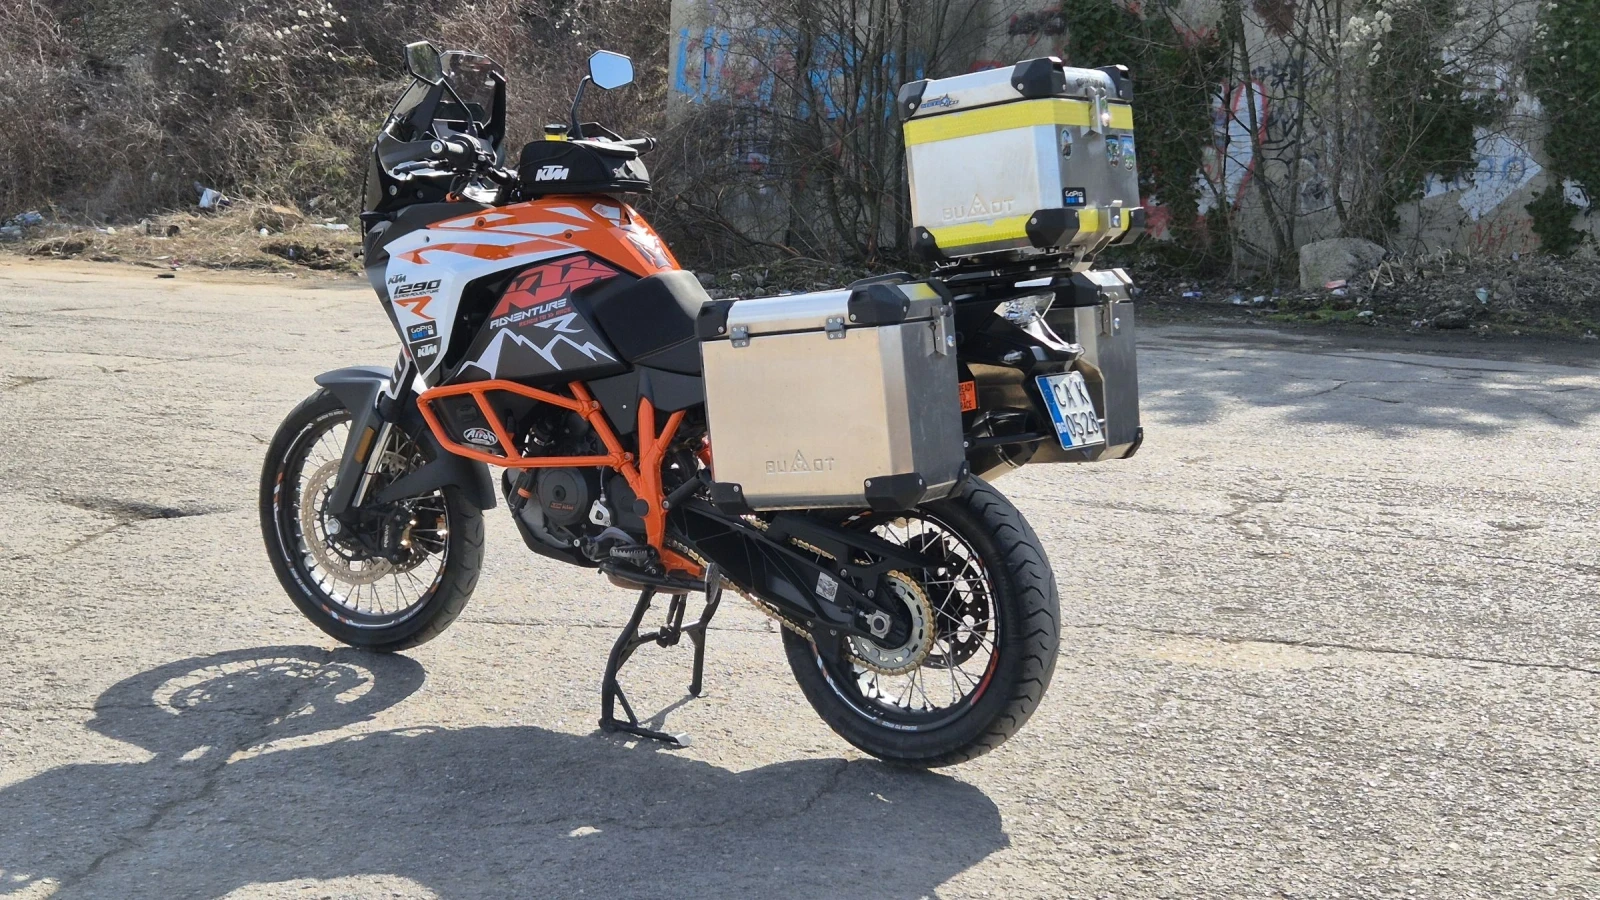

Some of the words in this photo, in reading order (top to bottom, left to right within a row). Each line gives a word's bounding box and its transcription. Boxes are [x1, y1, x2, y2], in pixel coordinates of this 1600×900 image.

[535, 165, 569, 181] KTM
[388, 274, 406, 284] KTM
[394, 279, 442, 294] 1290
[490, 255, 619, 318] KTM
[489, 298, 567, 330] ADVENTURE
[410, 324, 433, 334] GoPro
[417, 344, 438, 358] KTM
[1065, 411, 1099, 438] 0528
